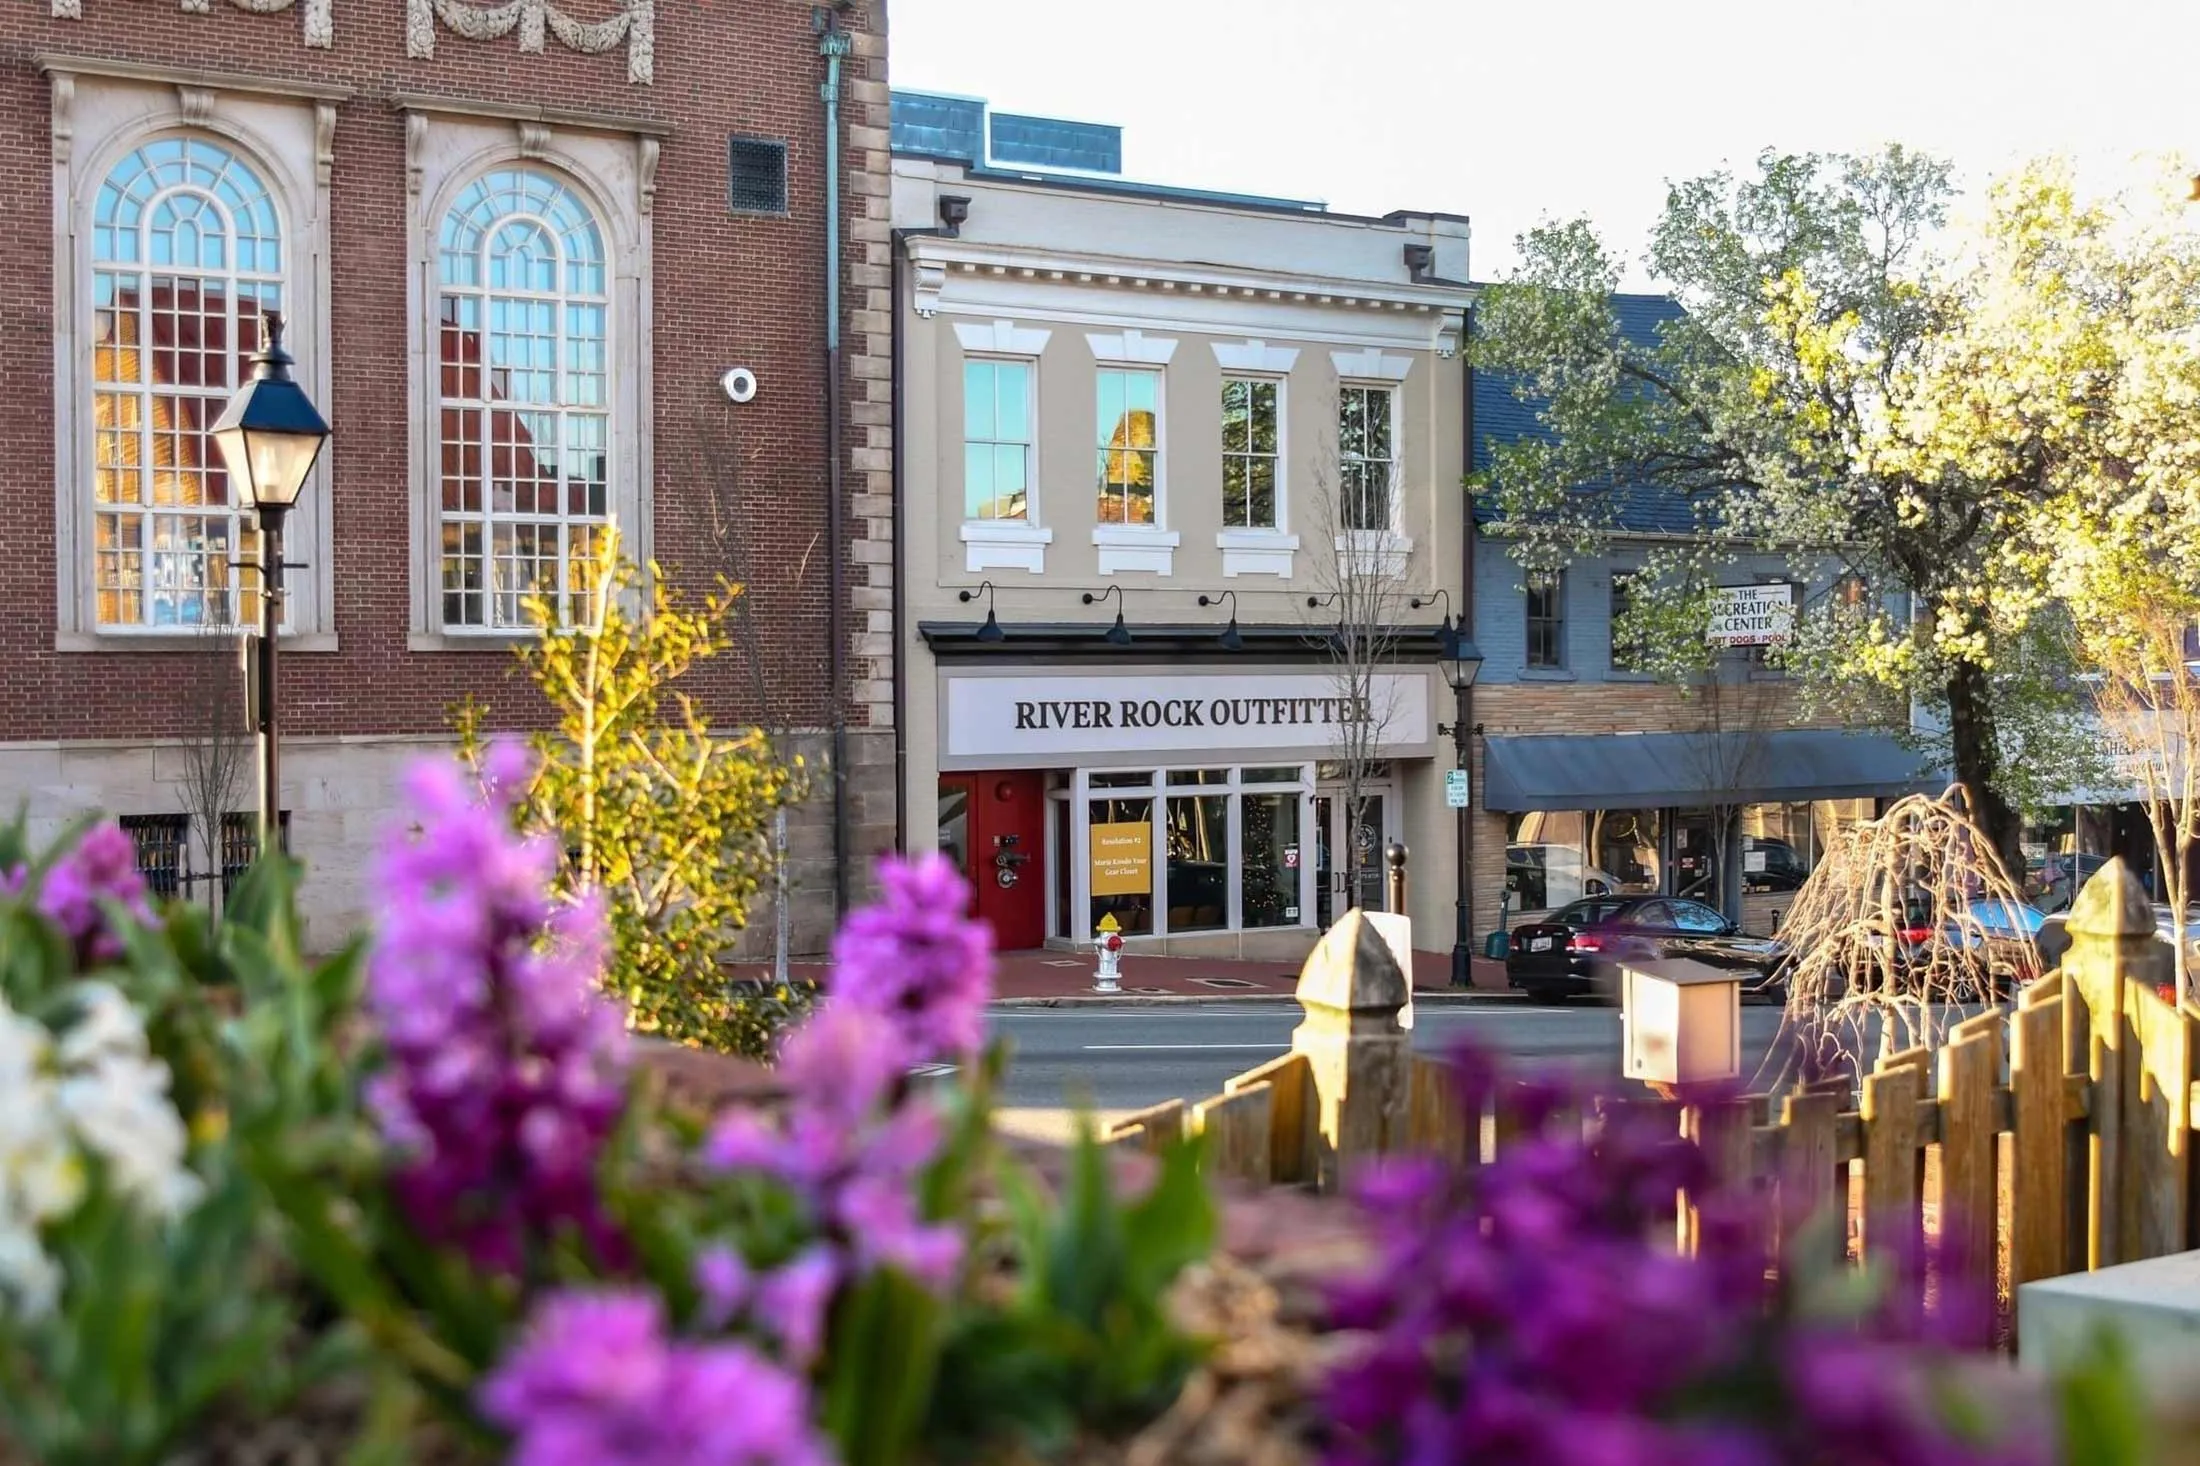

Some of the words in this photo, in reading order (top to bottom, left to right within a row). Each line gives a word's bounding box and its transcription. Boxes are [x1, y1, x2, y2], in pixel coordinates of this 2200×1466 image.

[1738, 589, 1758, 600] THE
[1724, 616, 1772, 631] CENTER
[1730, 635, 1756, 643] DOGS
[1762, 634, 1787, 642] POOL
[1015, 701, 1114, 729] RIVER
[1120, 699, 1205, 727] ROCK
